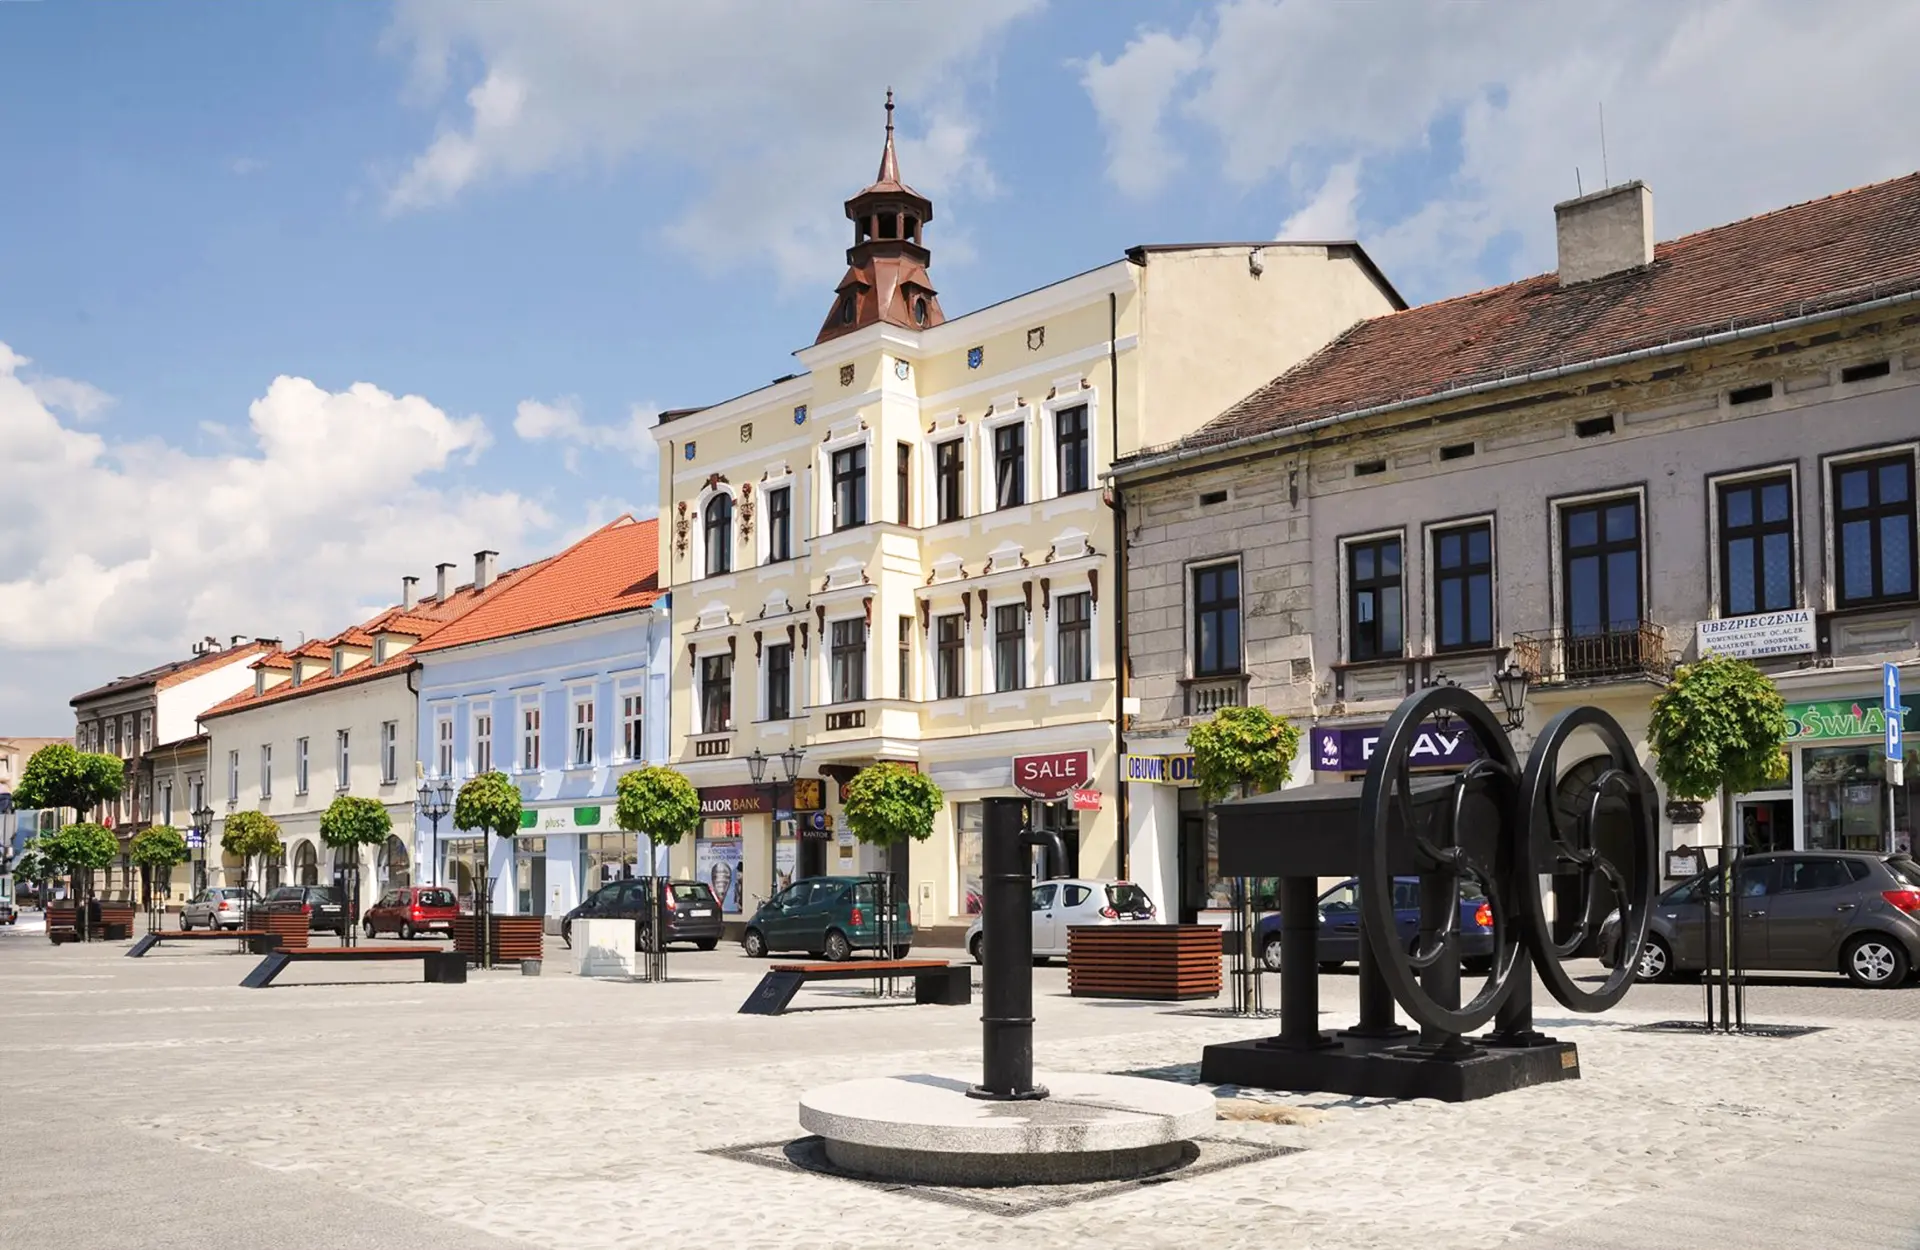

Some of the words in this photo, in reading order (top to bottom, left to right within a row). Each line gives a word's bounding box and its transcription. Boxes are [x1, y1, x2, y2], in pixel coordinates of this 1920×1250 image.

[1702, 612, 1809, 634] UBEZPIECZENIA
[1751, 642, 1811, 656] EMERYTALNE
[1363, 730, 1464, 760] PAY
[1889, 717, 1899, 754] P
[1024, 758, 1077, 780] SALE
[1129, 756, 1166, 780] OBUWIE
[1321, 758, 1339, 766] PLAY
[701, 799, 732, 812] ALIOR
[733, 797, 760, 810] BANK
[1073, 793, 1099, 803] SALE
